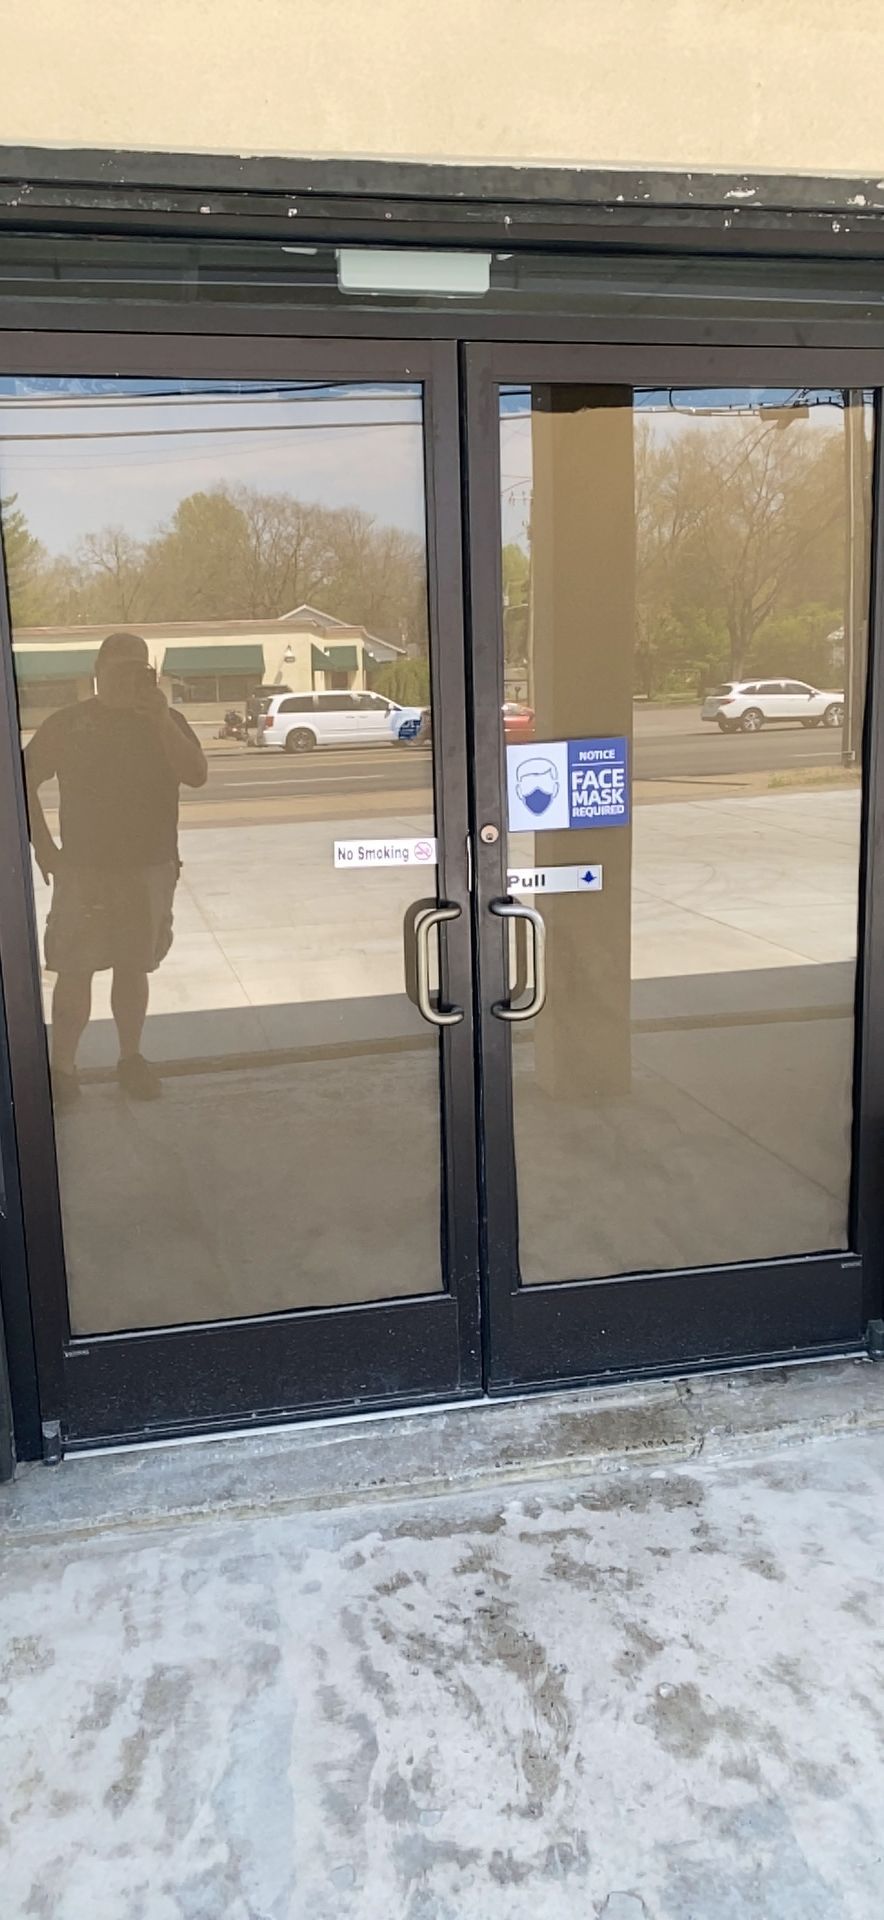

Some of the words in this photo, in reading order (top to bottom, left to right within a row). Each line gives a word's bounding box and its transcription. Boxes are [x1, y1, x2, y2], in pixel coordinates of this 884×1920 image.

[579, 749, 616, 761] NOTICE
[571, 769, 625, 790] FACE
[572, 789, 625, 807] MASK
[572, 805, 625, 818] REQUIRED
[338, 847, 353, 861] No
[358, 845, 409, 863] Smoking
[507, 874, 546, 888] Pull
